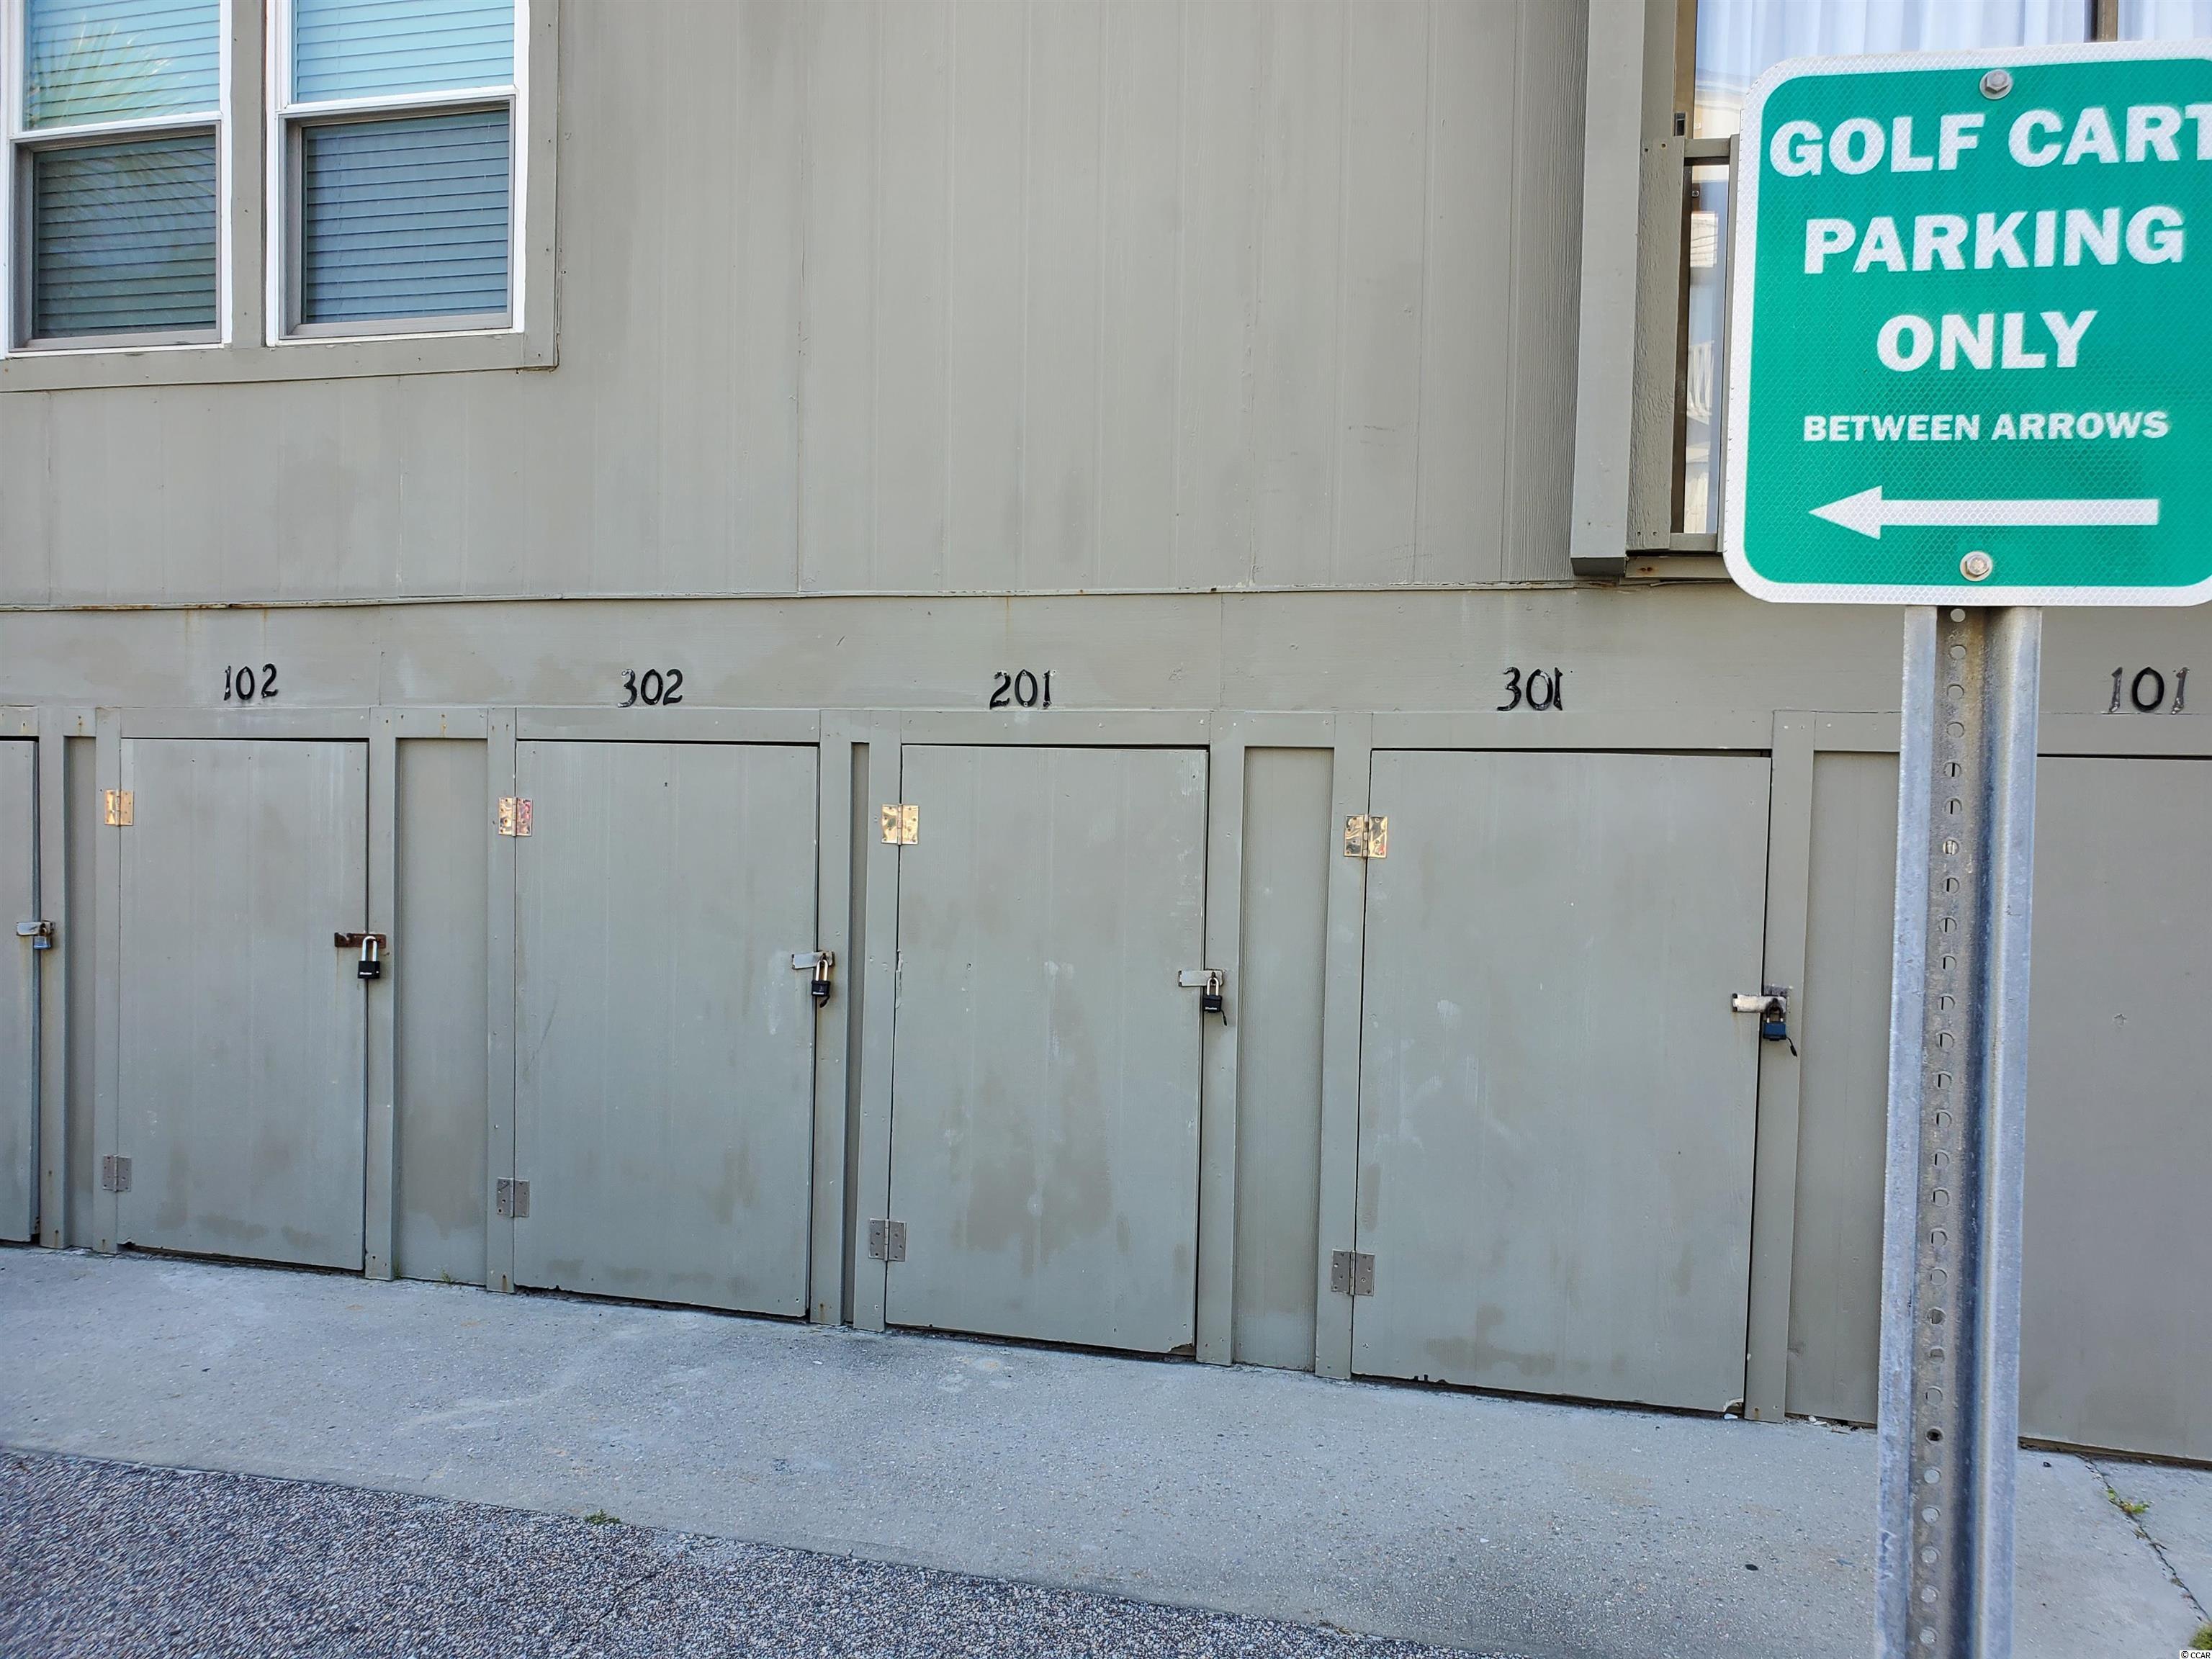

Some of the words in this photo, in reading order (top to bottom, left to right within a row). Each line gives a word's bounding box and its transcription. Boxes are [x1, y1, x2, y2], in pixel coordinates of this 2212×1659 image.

[1769, 113, 1986, 177] GOLF
[2008, 104, 2212, 168] CART
[1804, 206, 2185, 274] PARKING
[1876, 310, 2098, 372] ONLY
[1803, 414, 1979, 442] BETWEEN
[1991, 411, 2170, 441] ARROWS
[223, 663, 279, 701] 102
[617, 668, 683, 708] 302
[989, 669, 1052, 709] 201
[1497, 667, 1563, 711] 301
[2108, 666, 2190, 714] 101
